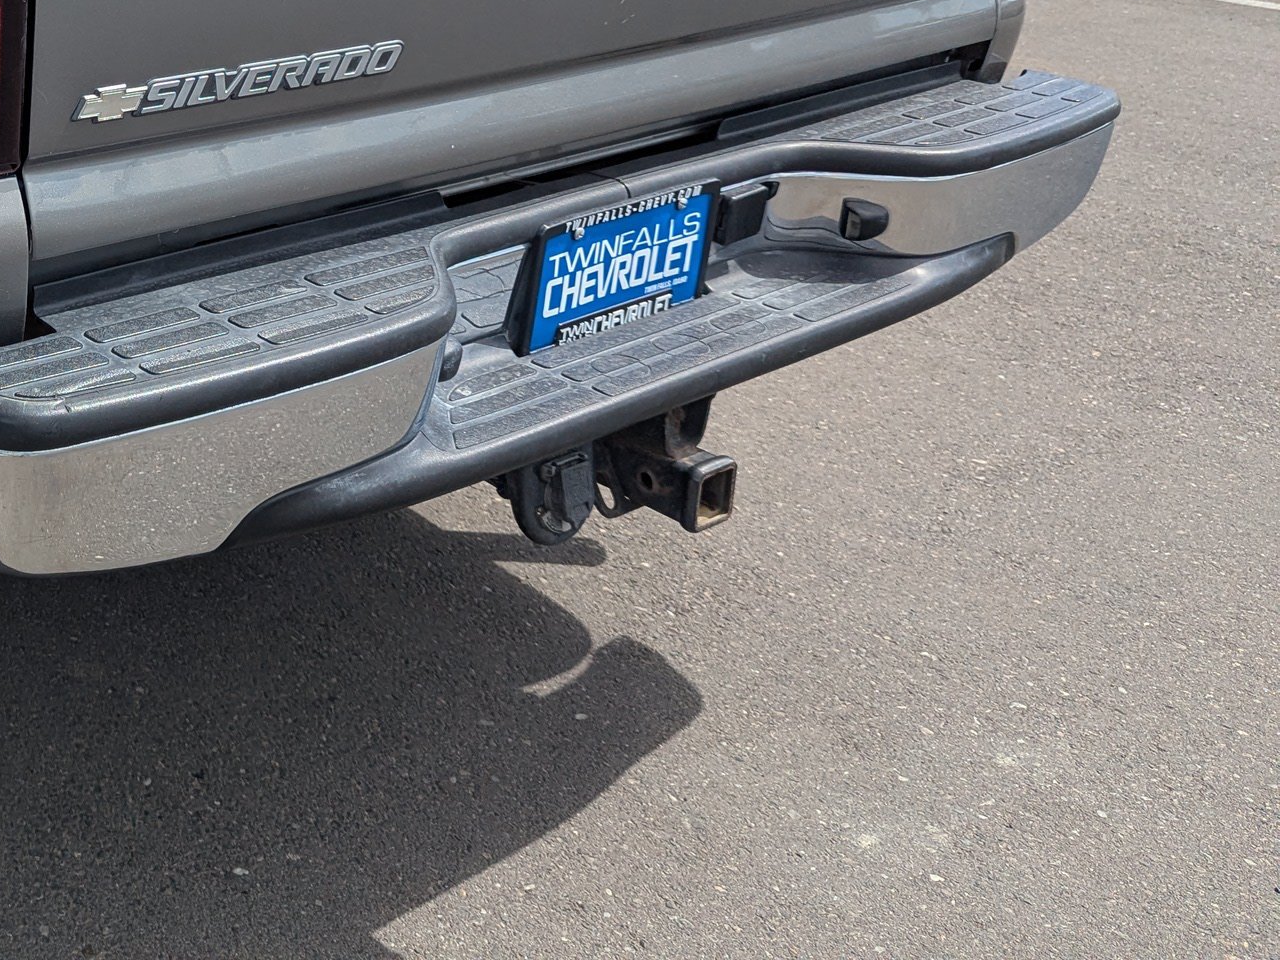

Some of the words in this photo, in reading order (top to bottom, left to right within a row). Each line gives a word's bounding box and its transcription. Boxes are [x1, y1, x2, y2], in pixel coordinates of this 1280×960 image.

[140, 41, 404, 115] SILVERADO
[542, 234, 698, 318] CHEVROLET
[560, 319, 593, 341] TWIN
